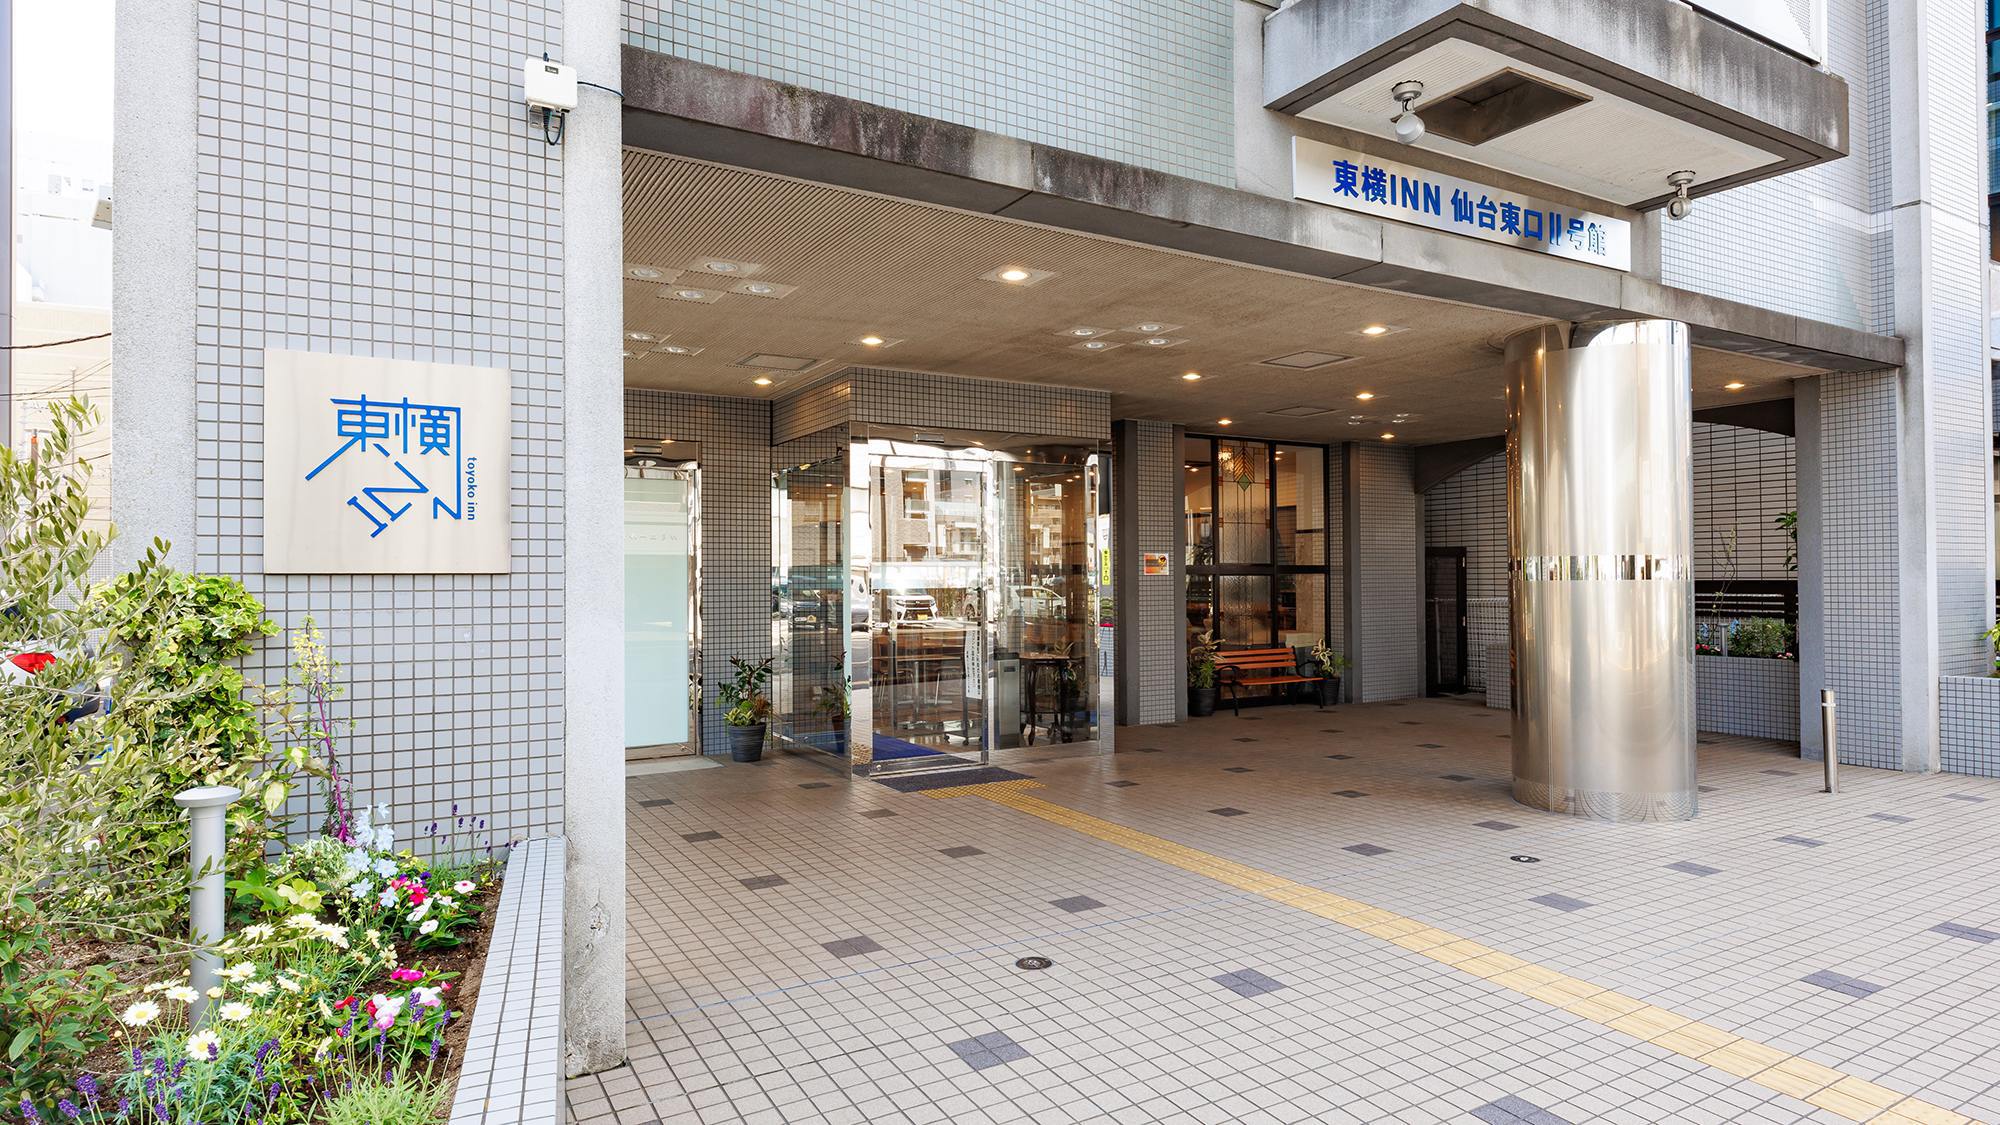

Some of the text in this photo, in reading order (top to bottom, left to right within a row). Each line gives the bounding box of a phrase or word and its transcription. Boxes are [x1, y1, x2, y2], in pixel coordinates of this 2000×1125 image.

[1332, 159, 1441, 216] 東横INN
[465, 457, 478, 520] toyoko inn
